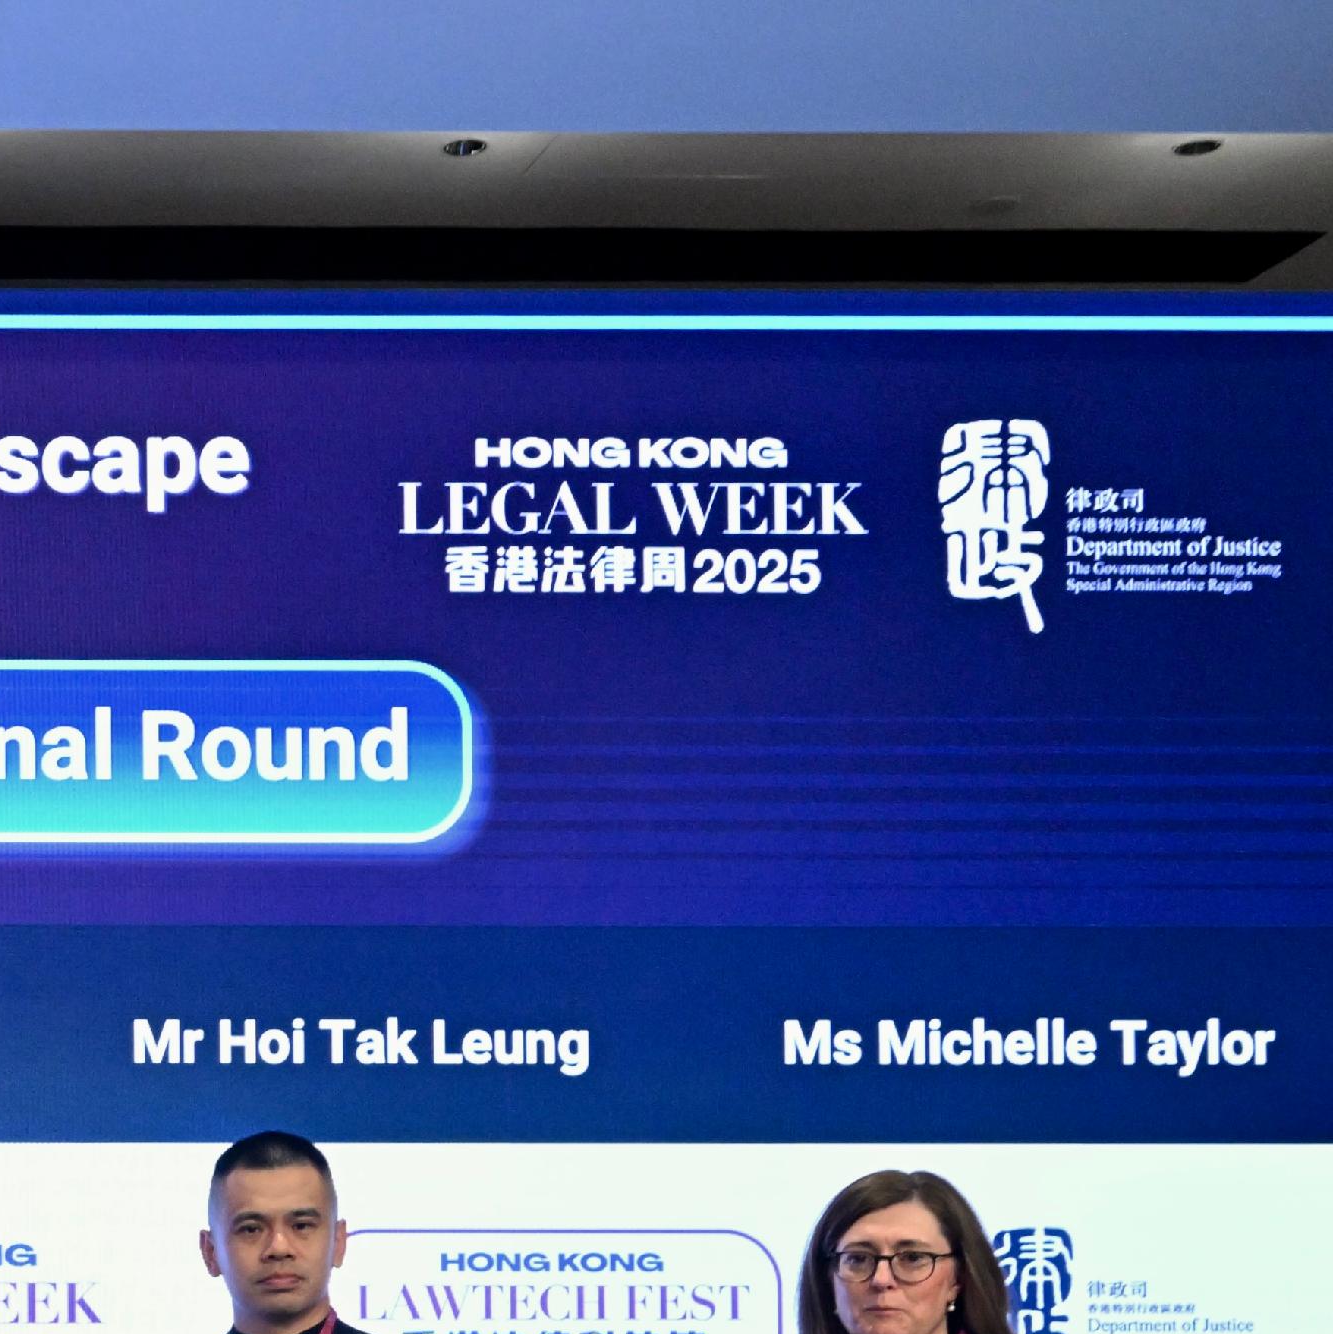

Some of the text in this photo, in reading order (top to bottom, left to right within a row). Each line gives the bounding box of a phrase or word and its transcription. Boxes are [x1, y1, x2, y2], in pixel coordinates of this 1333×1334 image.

[475, 436, 788, 468] HONG KONG
[398, 481, 869, 536] LEGAL WEEK
[1066, 487, 1144, 513] 律政司
[1066, 535, 1281, 561] Department of Justice
[142, 706, 409, 781] Round
[133, 1017, 589, 1076] Mr Hoi Tak Leung
[784, 1017, 1276, 1077] Ms Michelle Taylor
[441, 1252, 664, 1272] HONG KONG
[360, 1285, 749, 1320] LAWTECH FEST
[1088, 1318, 1253, 1334] Department of Justice
